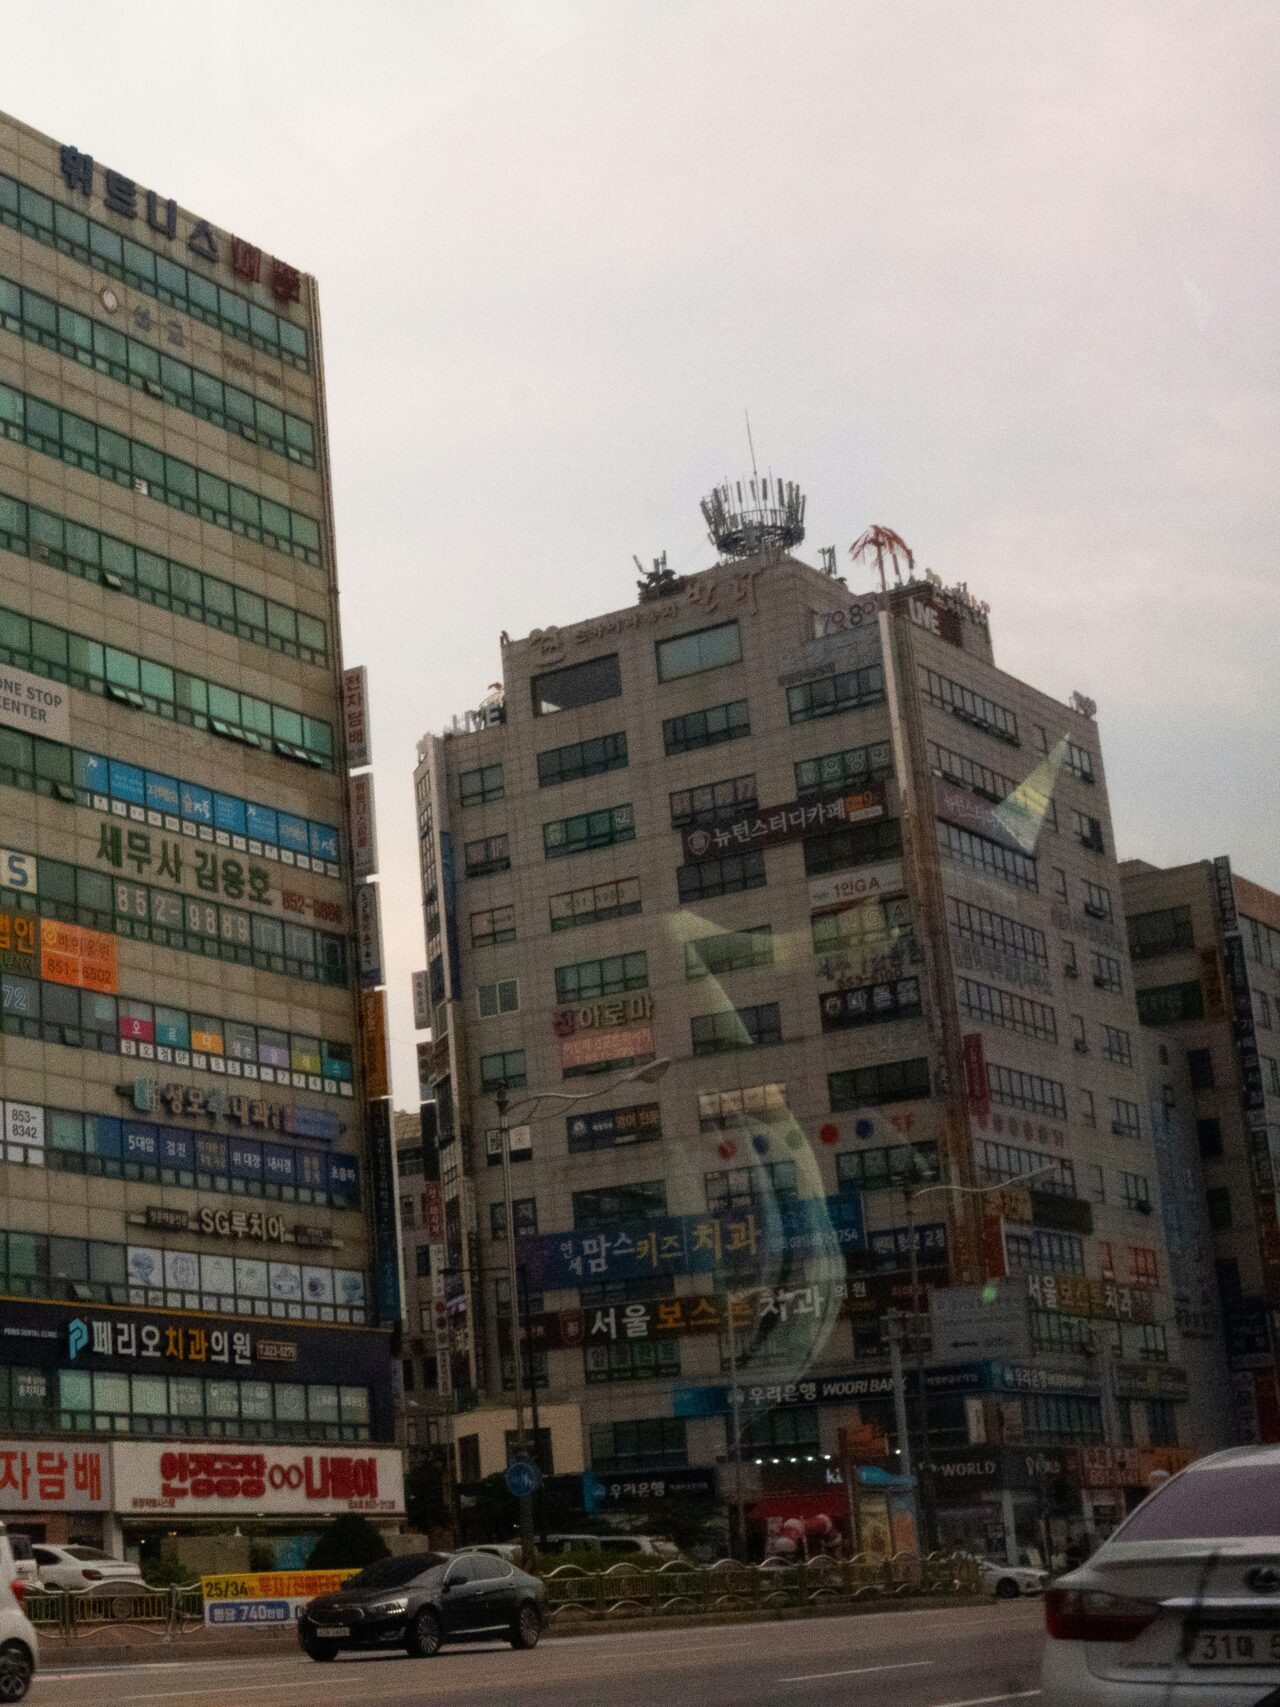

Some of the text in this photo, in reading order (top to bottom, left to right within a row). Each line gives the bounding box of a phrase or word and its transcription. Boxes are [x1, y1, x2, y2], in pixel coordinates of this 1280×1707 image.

[26, 686, 62, 708] STOP
[97, 823, 182, 884] 세무사
[91, 1319, 253, 1366] 페리오치과의원
[749, 1381, 818, 1406] 우리은행
